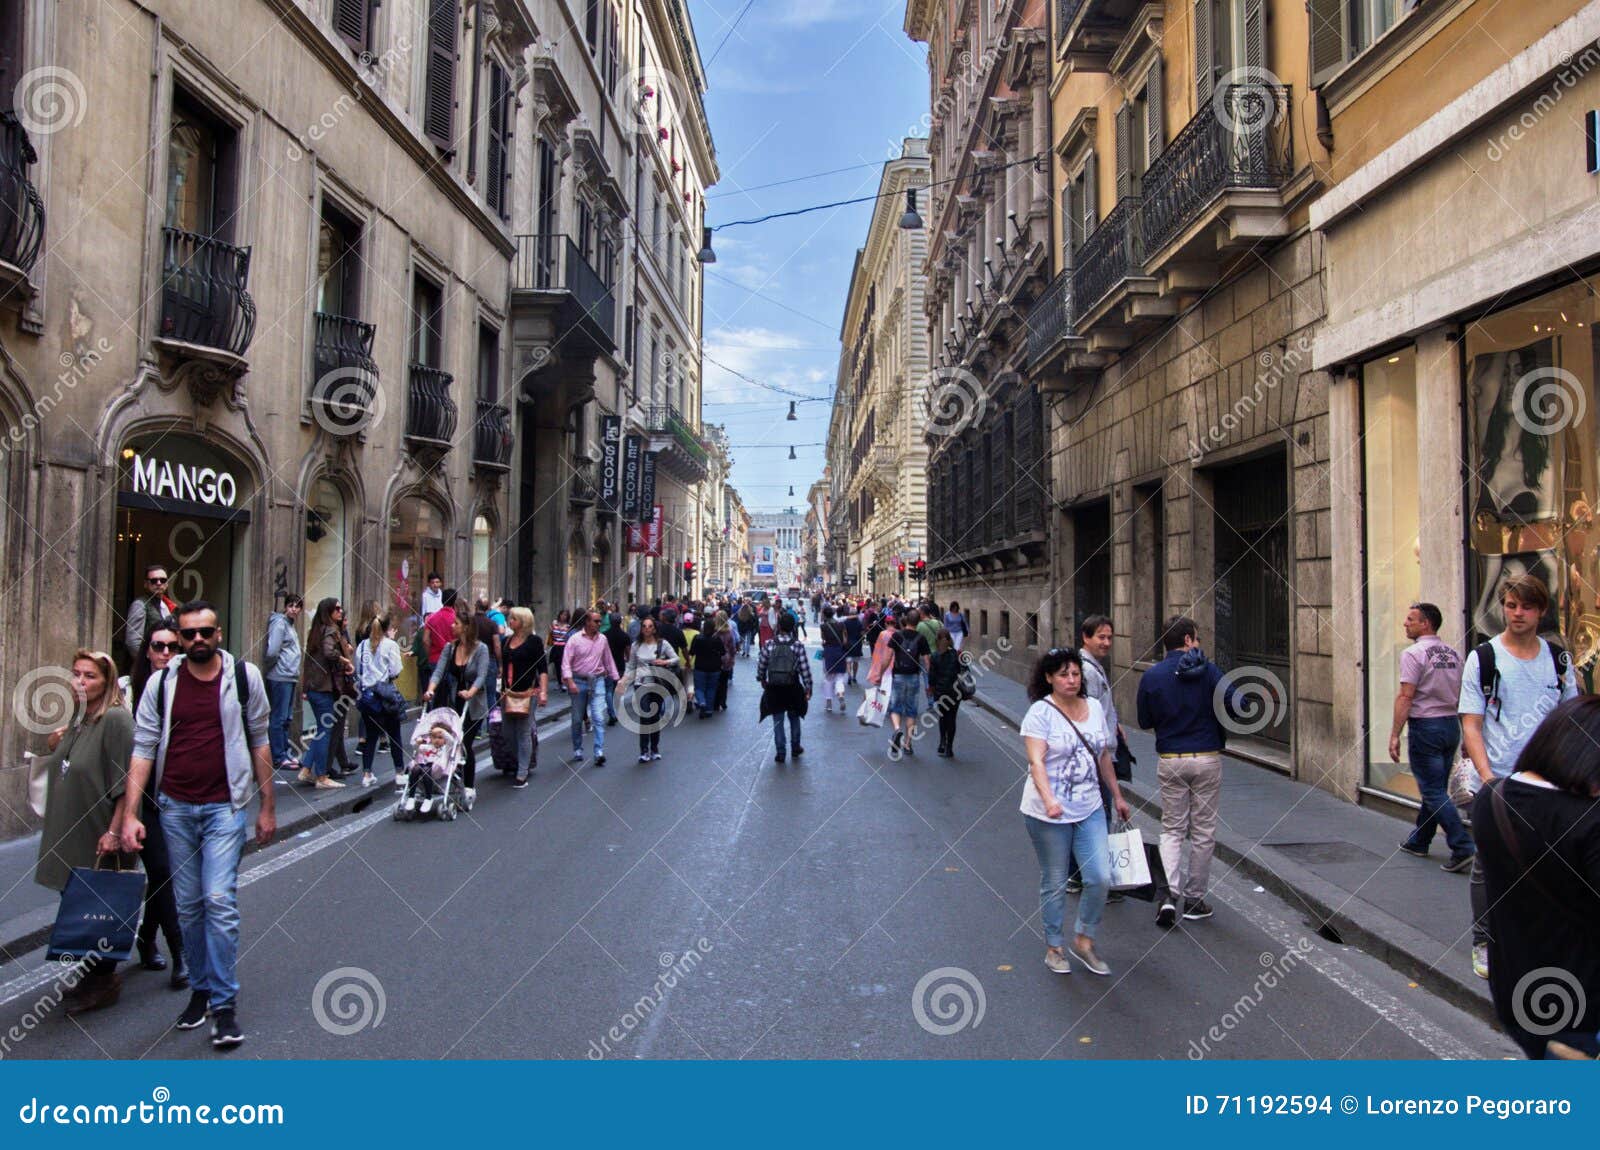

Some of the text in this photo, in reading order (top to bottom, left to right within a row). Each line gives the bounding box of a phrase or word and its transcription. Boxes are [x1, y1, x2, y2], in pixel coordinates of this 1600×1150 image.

[603, 419, 618, 499] LE GROUP
[628, 439, 638, 459] LE
[133, 454, 236, 507] MANGO
[624, 462, 637, 511] GROUP
[642, 454, 654, 520] LE GROUP
[83, 913, 114, 921] ZARA
